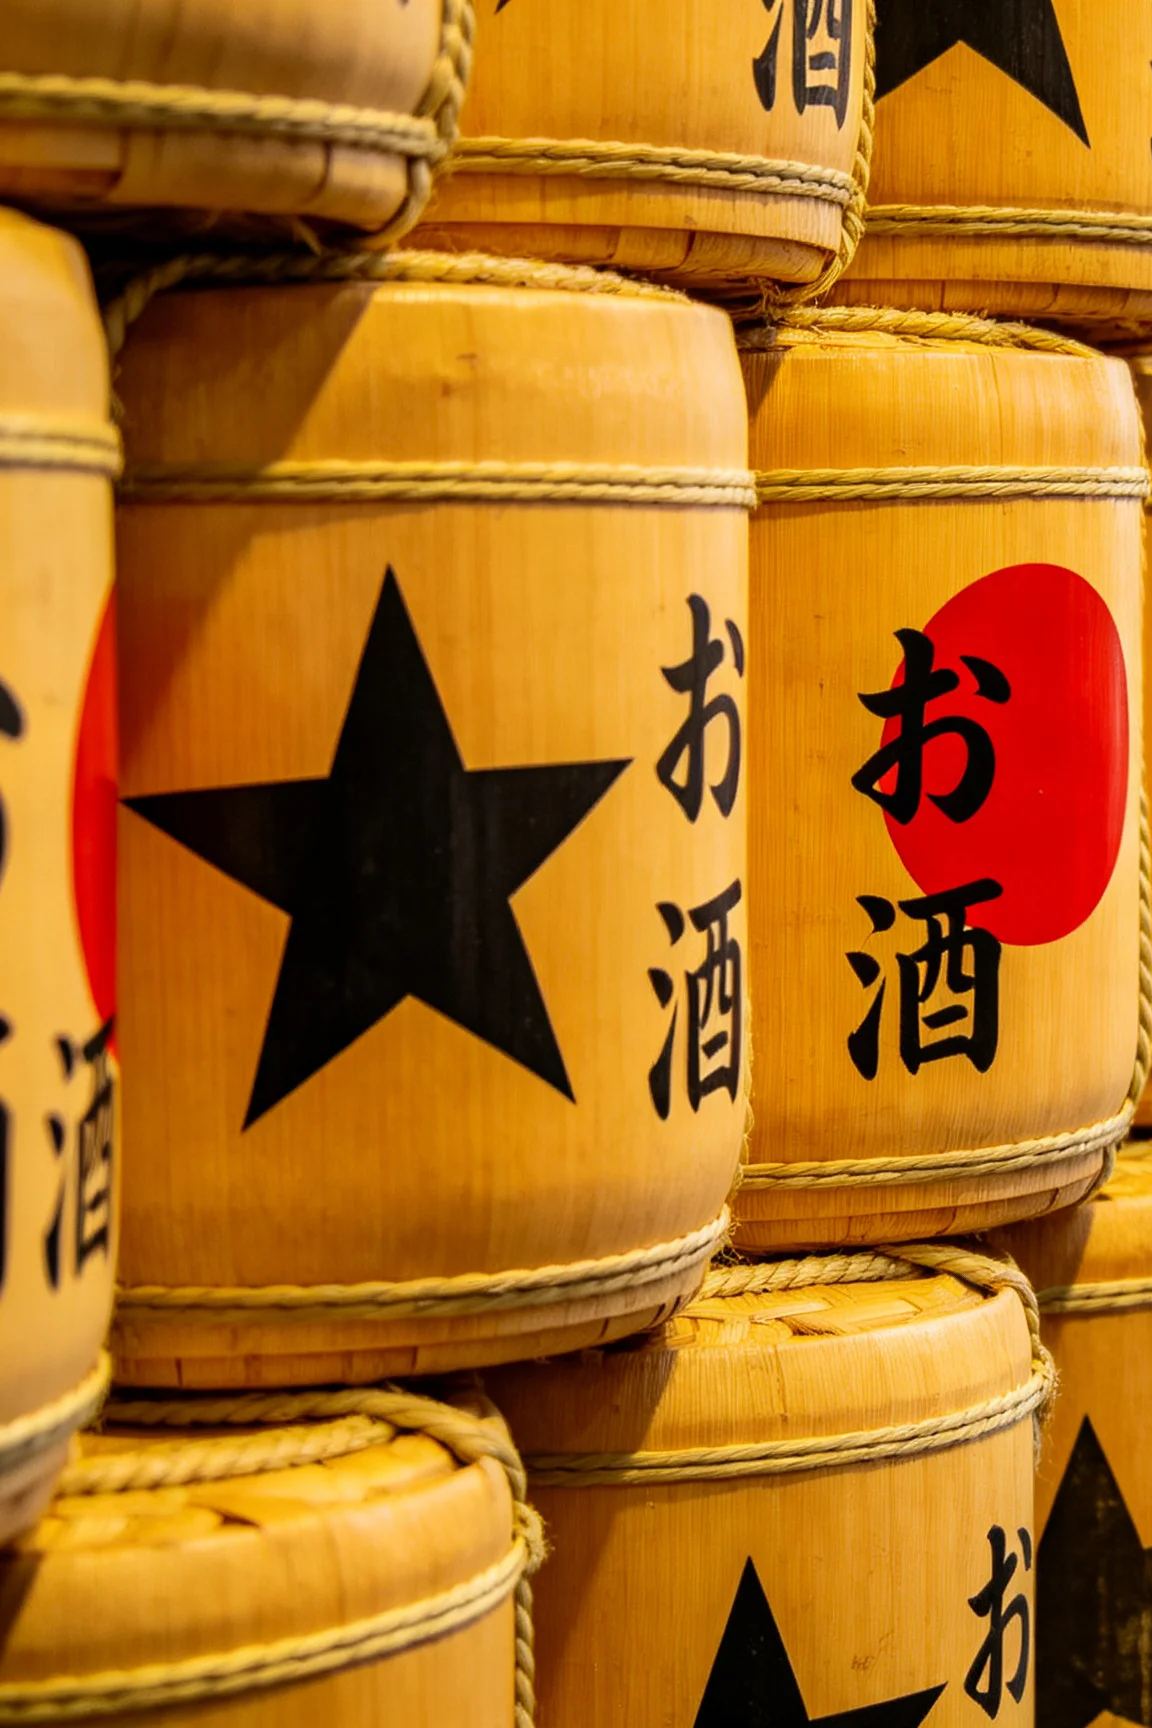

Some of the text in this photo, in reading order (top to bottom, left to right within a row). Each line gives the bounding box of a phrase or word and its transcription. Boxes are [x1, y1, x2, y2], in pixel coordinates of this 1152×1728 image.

[648, 592, 746, 1121] お酒
[845, 627, 1012, 1082] お酒
[963, 1524, 1033, 1721] お
